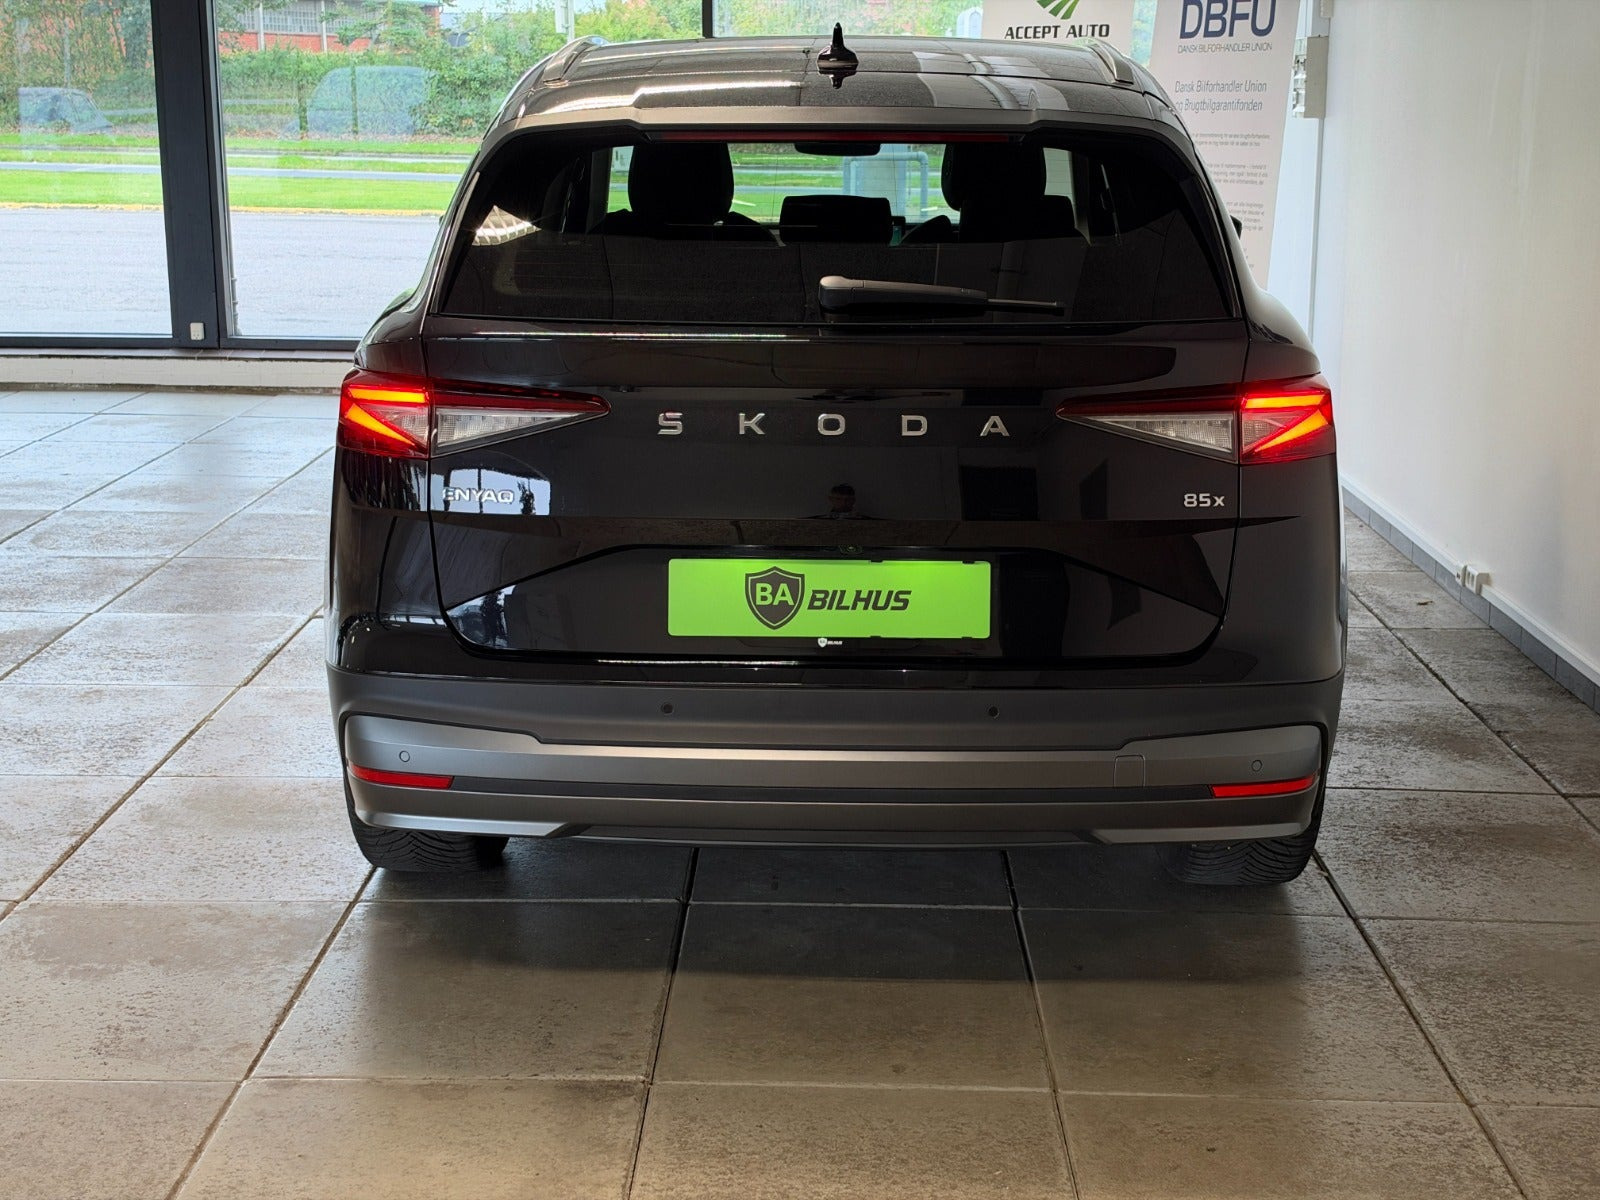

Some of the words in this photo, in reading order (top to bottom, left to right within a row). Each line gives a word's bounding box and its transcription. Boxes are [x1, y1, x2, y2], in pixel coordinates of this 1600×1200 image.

[1179, 0, 1276, 39] DBFU
[1004, 25, 1061, 39] ACCEPT
[1066, 24, 1110, 38] AUTO
[1177, 44, 1197, 54] DANSK
[1251, 41, 1273, 52] UNION
[1174, 80, 1195, 93] Dansk
[1196, 79, 1244, 93] Bilforhandler
[1244, 79, 1267, 92] Union
[1184, 98, 1263, 113] Brugtbilgarantifonden
[657, 411, 1010, 437] SKODA
[442, 486, 514, 504] ENYAQ
[1183, 493, 1225, 508] 85x
[755, 583, 795, 606] BA
[807, 589, 912, 611] BILHUS
